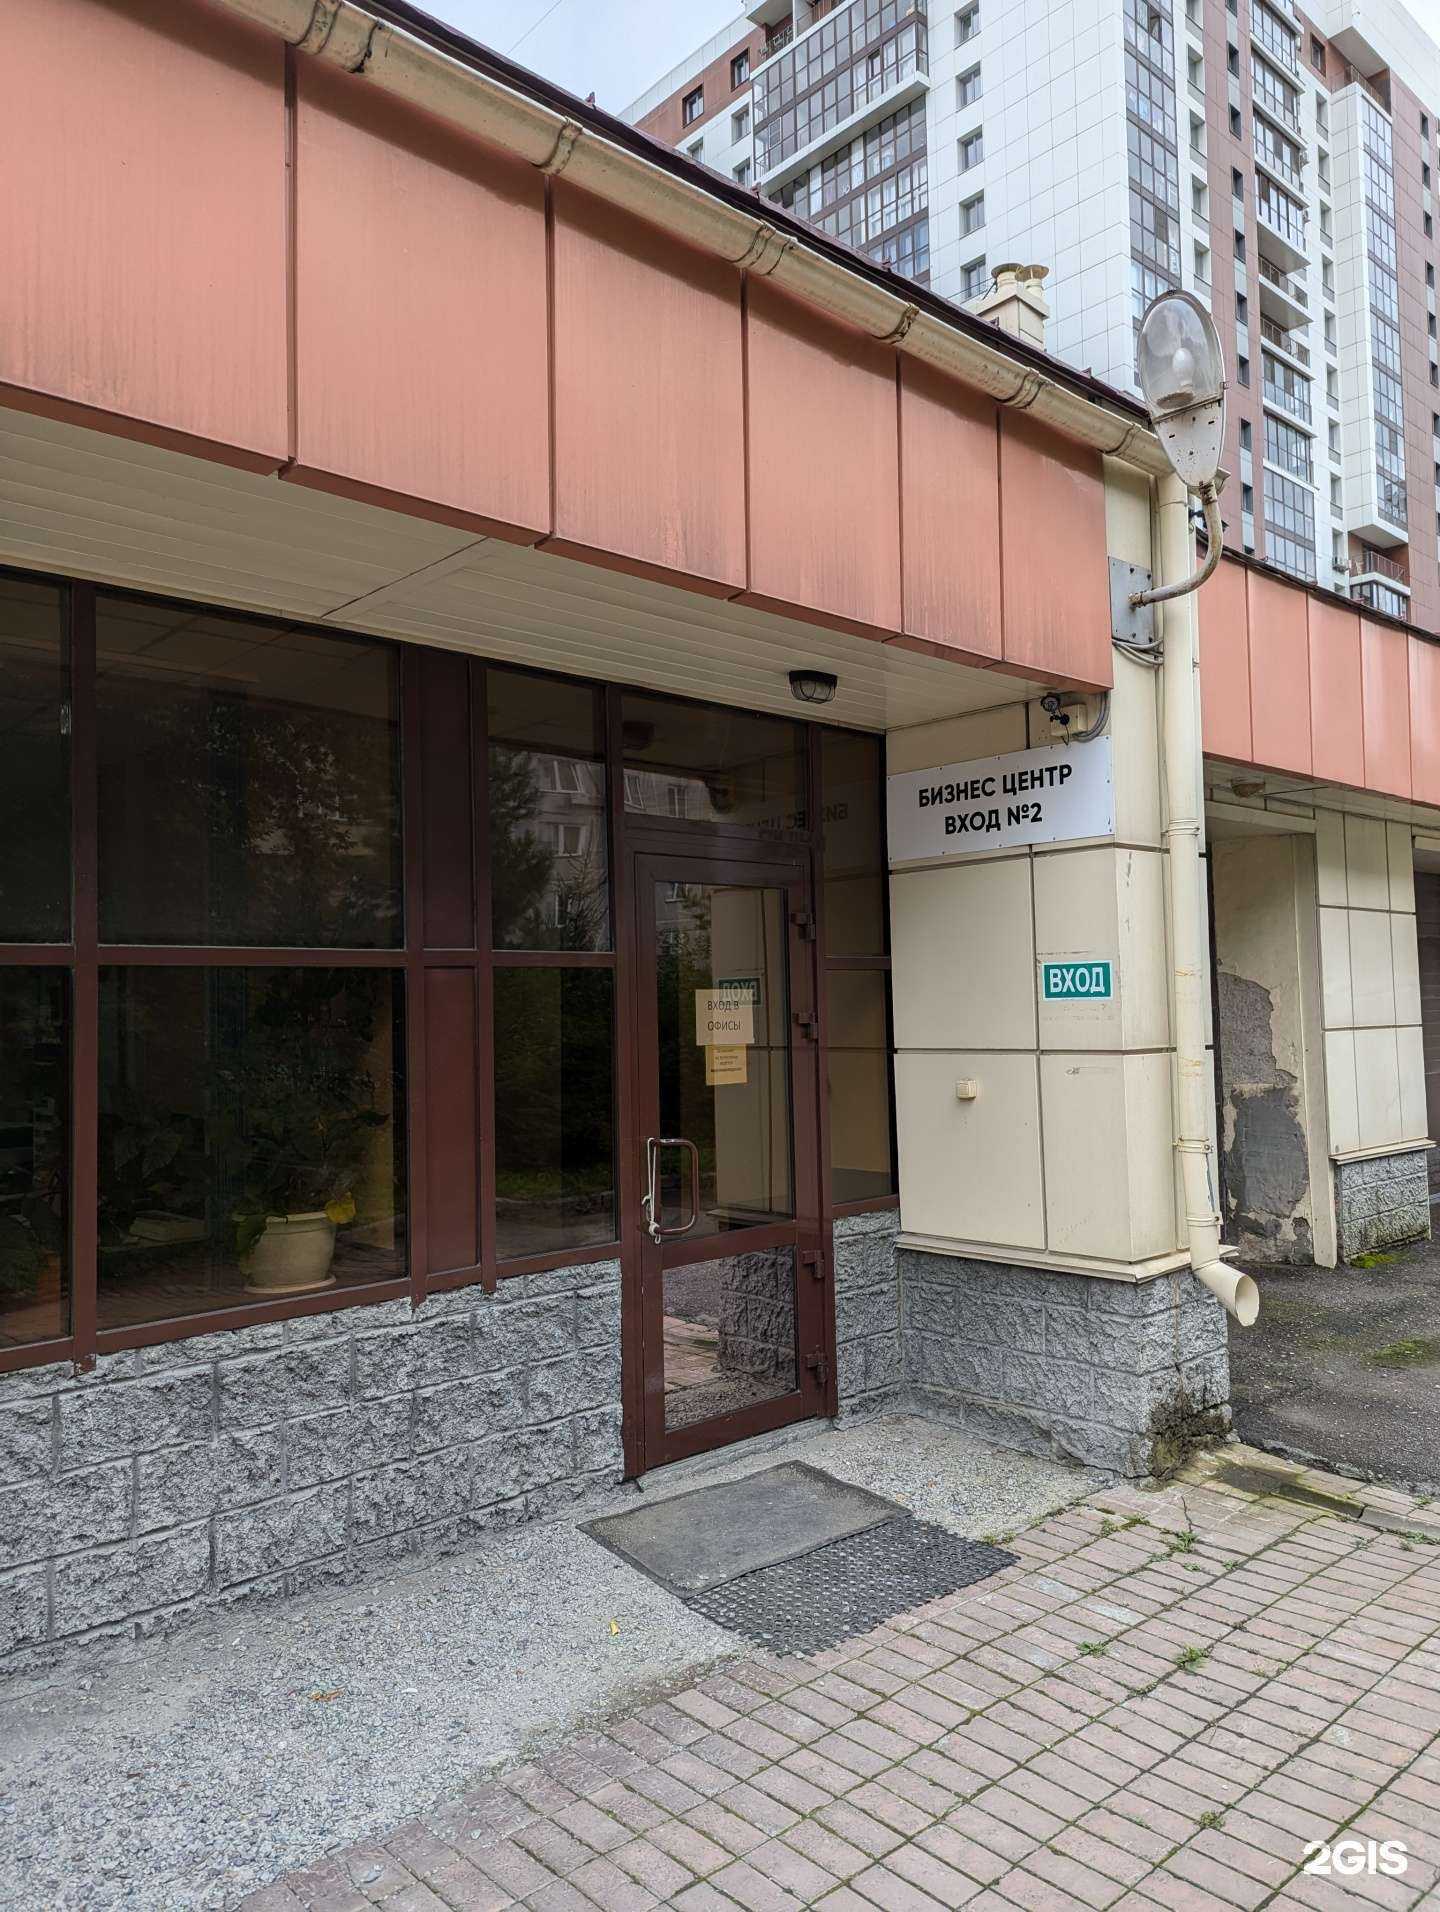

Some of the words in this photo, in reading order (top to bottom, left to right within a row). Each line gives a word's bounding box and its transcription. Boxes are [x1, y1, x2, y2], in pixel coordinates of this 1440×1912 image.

[918, 777, 996, 808] БИЗНЕС
[1002, 764, 1073, 796] ЦЕНТР
[944, 808, 1001, 835] ВХОД
[1007, 802, 1043, 826] №2
[1049, 967, 1105, 993] ВХОД
[707, 1000, 732, 1012] ВХОД
[732, 1000, 740, 1010] В
[707, 1021, 741, 1032] ОФИСЫ
